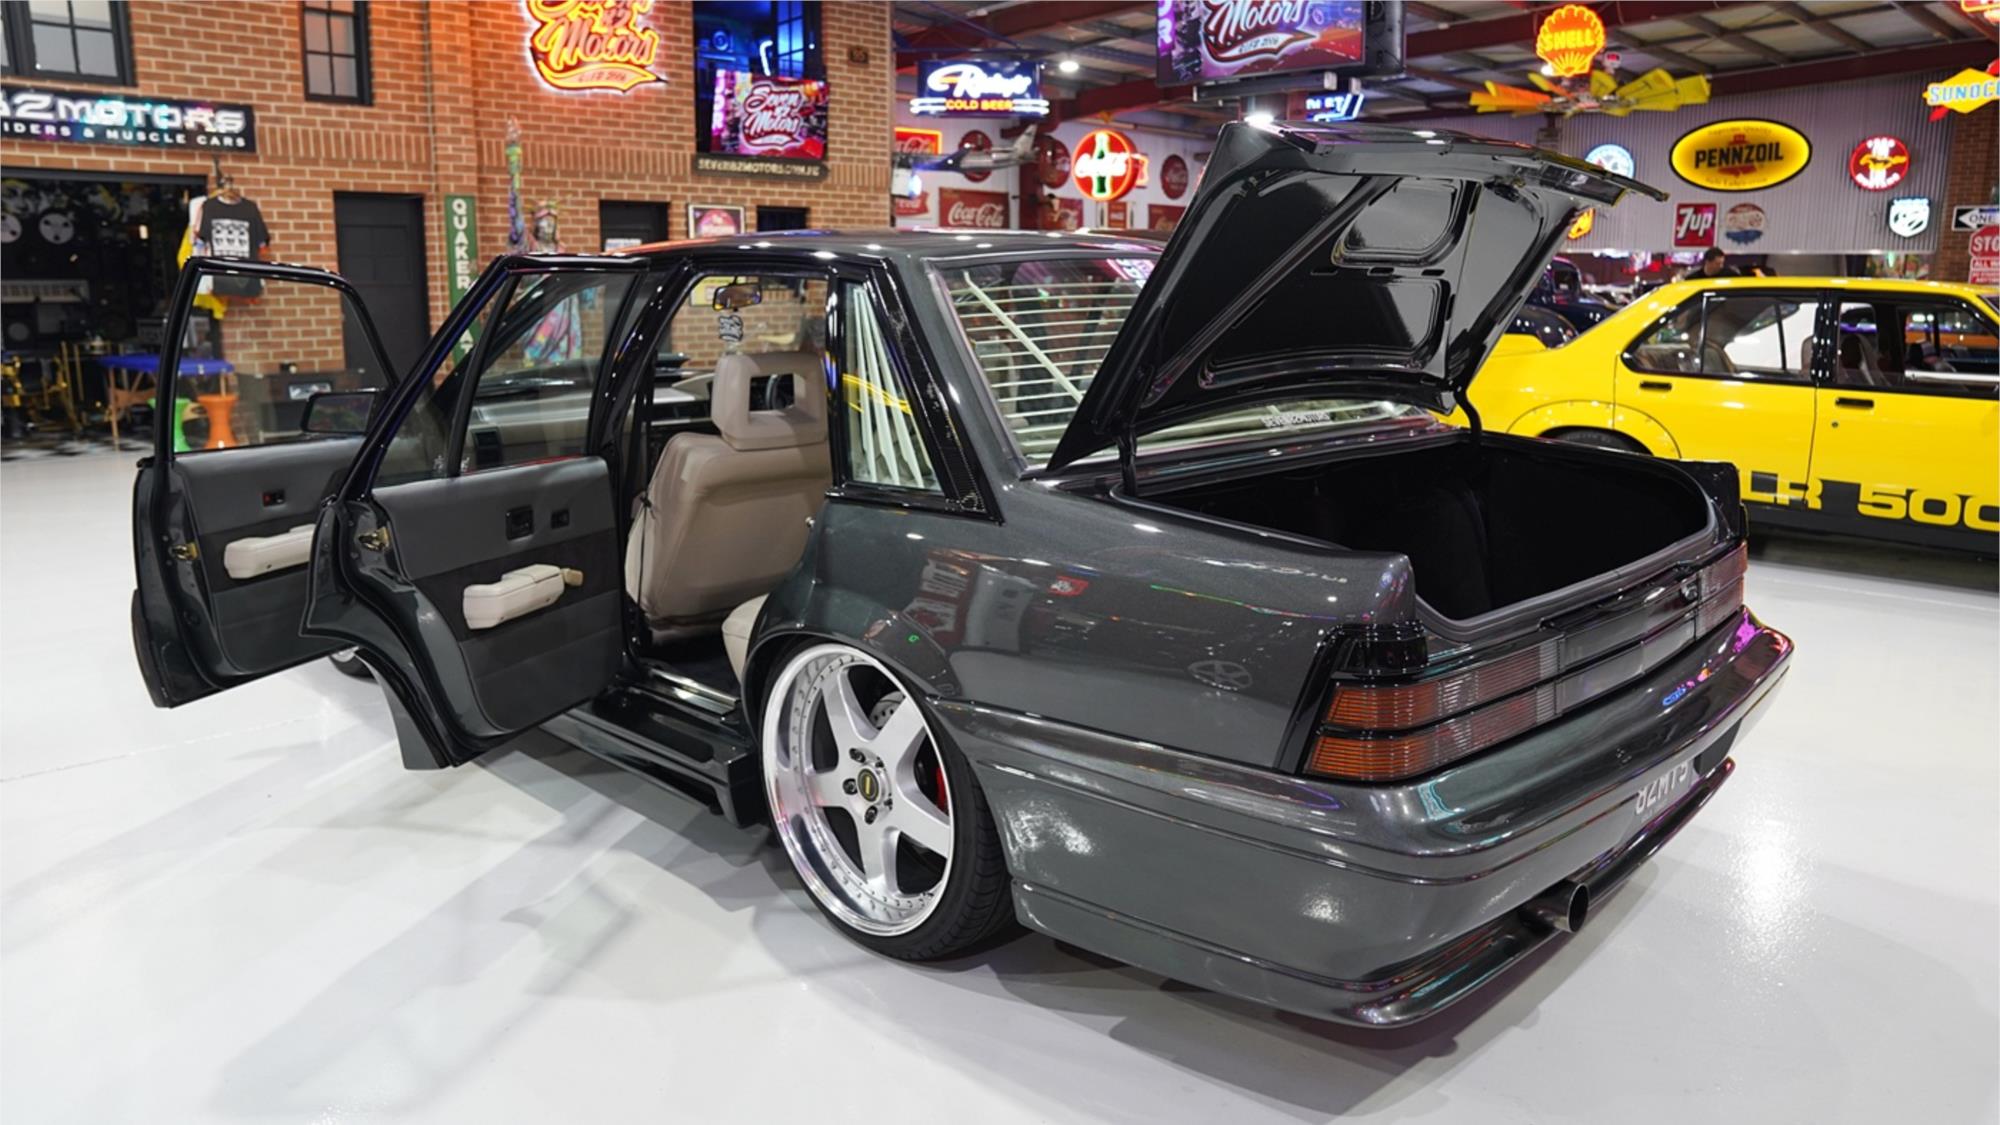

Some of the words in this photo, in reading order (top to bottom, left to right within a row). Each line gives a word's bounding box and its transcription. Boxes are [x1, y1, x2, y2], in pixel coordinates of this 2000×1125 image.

[536, 16, 659, 70] Motors
[1543, 28, 1595, 52] SHELL
[945, 99, 979, 111] COLD
[980, 99, 1013, 112] BEER
[3, 121, 72, 138] IDERS
[106, 128, 187, 145] MUSCLE
[196, 133, 247, 148] CARS
[1694, 142, 1784, 169] PENNZOIL
[452, 198, 470, 290] QUAKER
[1972, 235, 2000, 253] STO
[1740, 470, 1822, 511] LR
[1857, 481, 2000, 534] 500
